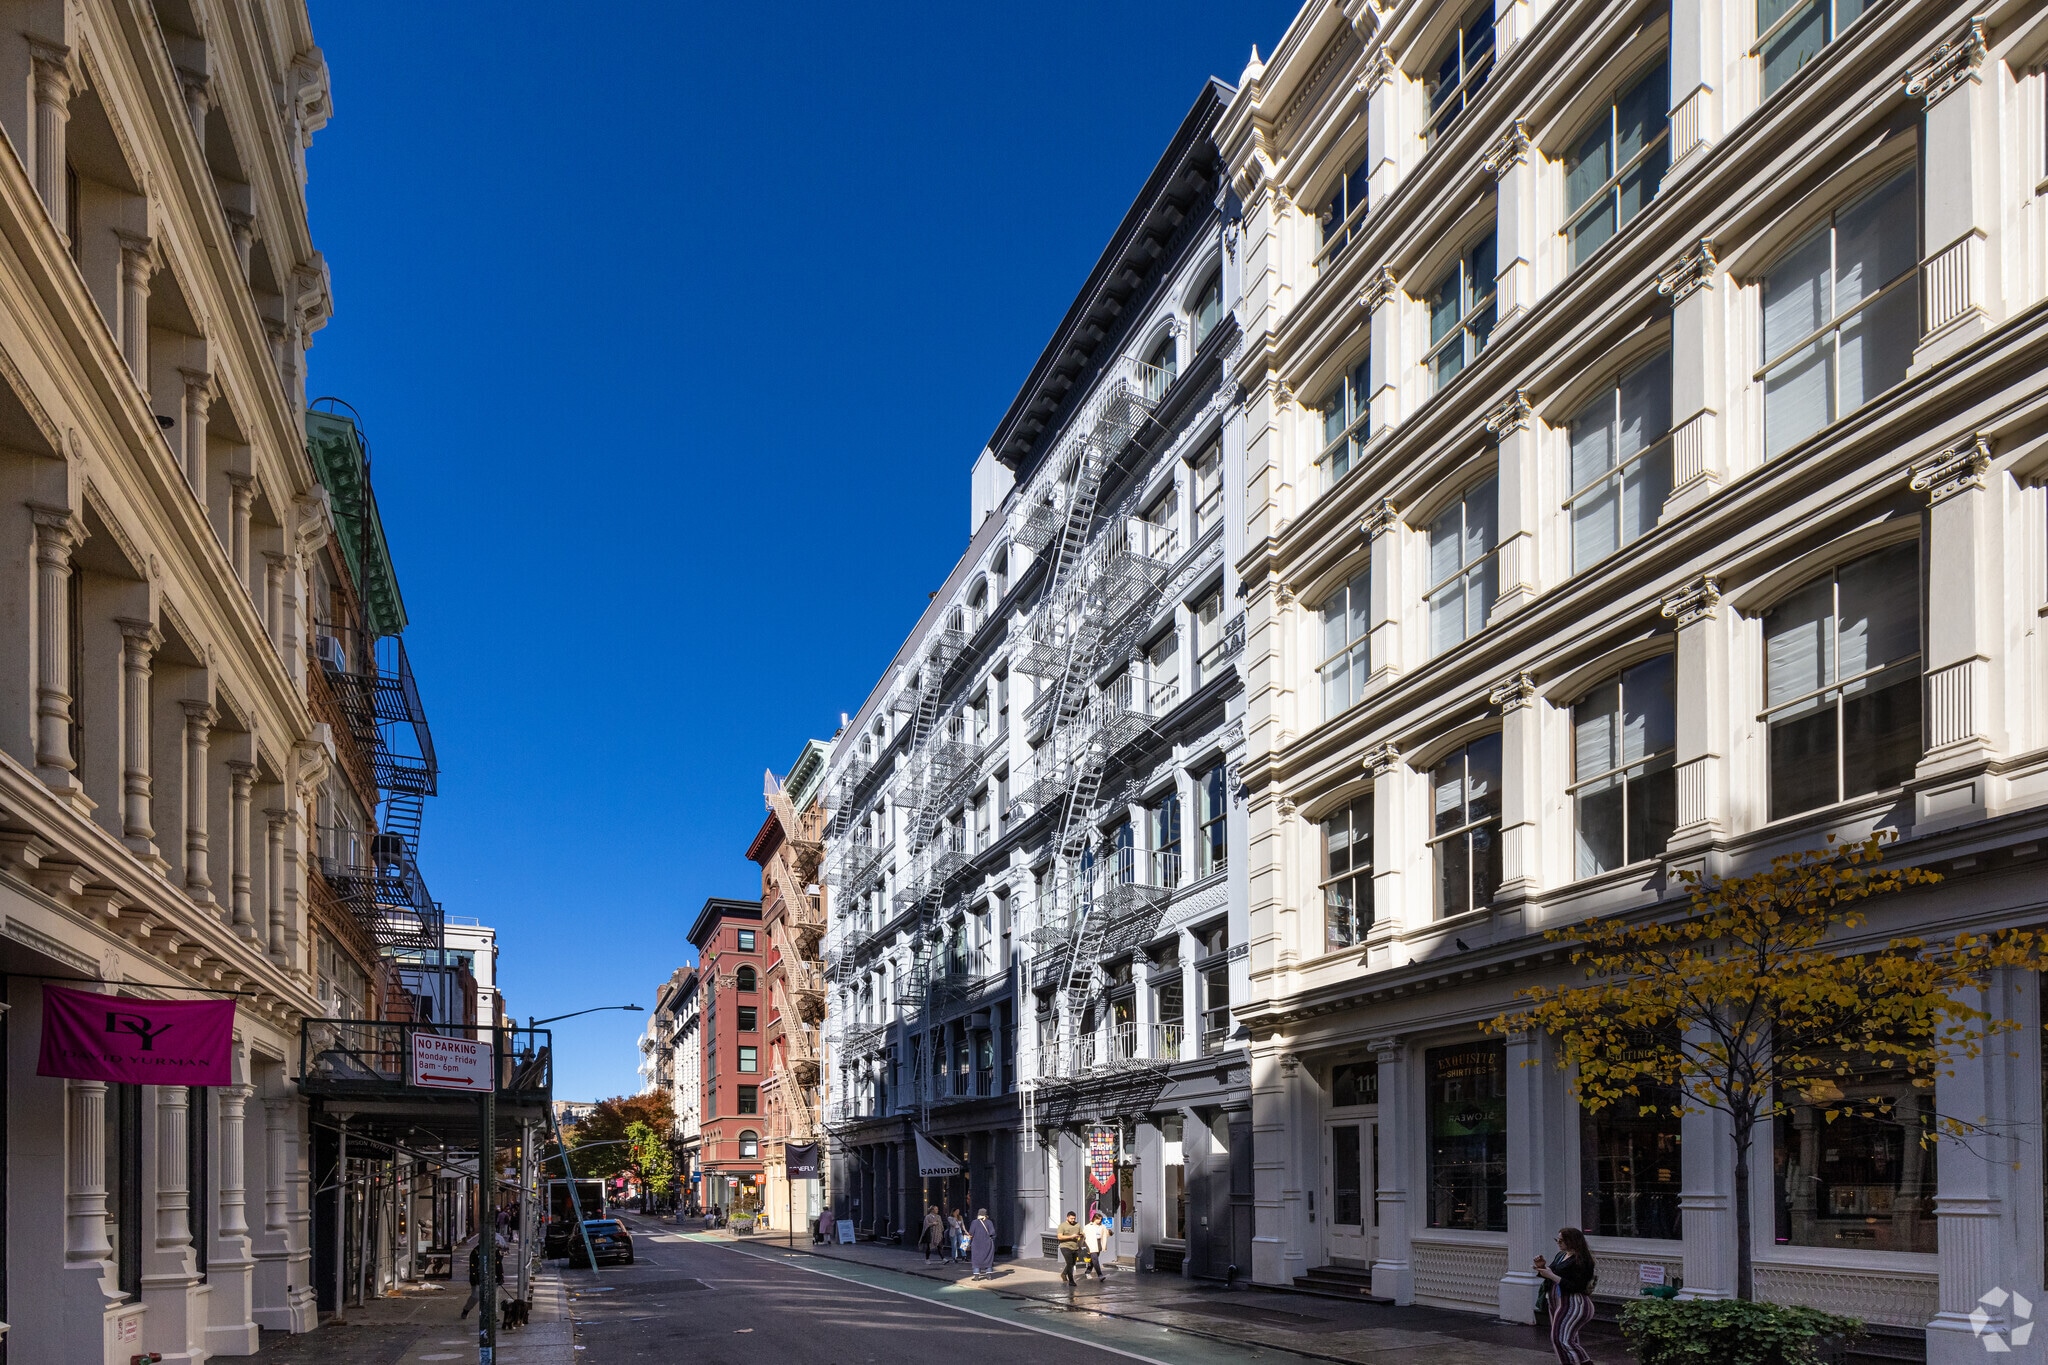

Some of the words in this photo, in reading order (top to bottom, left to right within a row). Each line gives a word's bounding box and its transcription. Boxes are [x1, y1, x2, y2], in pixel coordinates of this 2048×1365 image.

[105, 1012, 175, 1051] DY
[418, 1039, 432, 1049] NO
[435, 1041, 477, 1054] PARKING
[63, 1050, 123, 1063] DAVID
[129, 1056, 211, 1067] YURMAN
[418, 1051, 448, 1062] Monday
[455, 1056, 477, 1066] Friday
[418, 1061, 436, 1070] 8am
[442, 1064, 459, 1072] 6pm
[1438, 1052, 1497, 1070] EXQUISITE
[1356, 1073, 1377, 1092] 111
[921, 1167, 959, 1175] SANDRO
